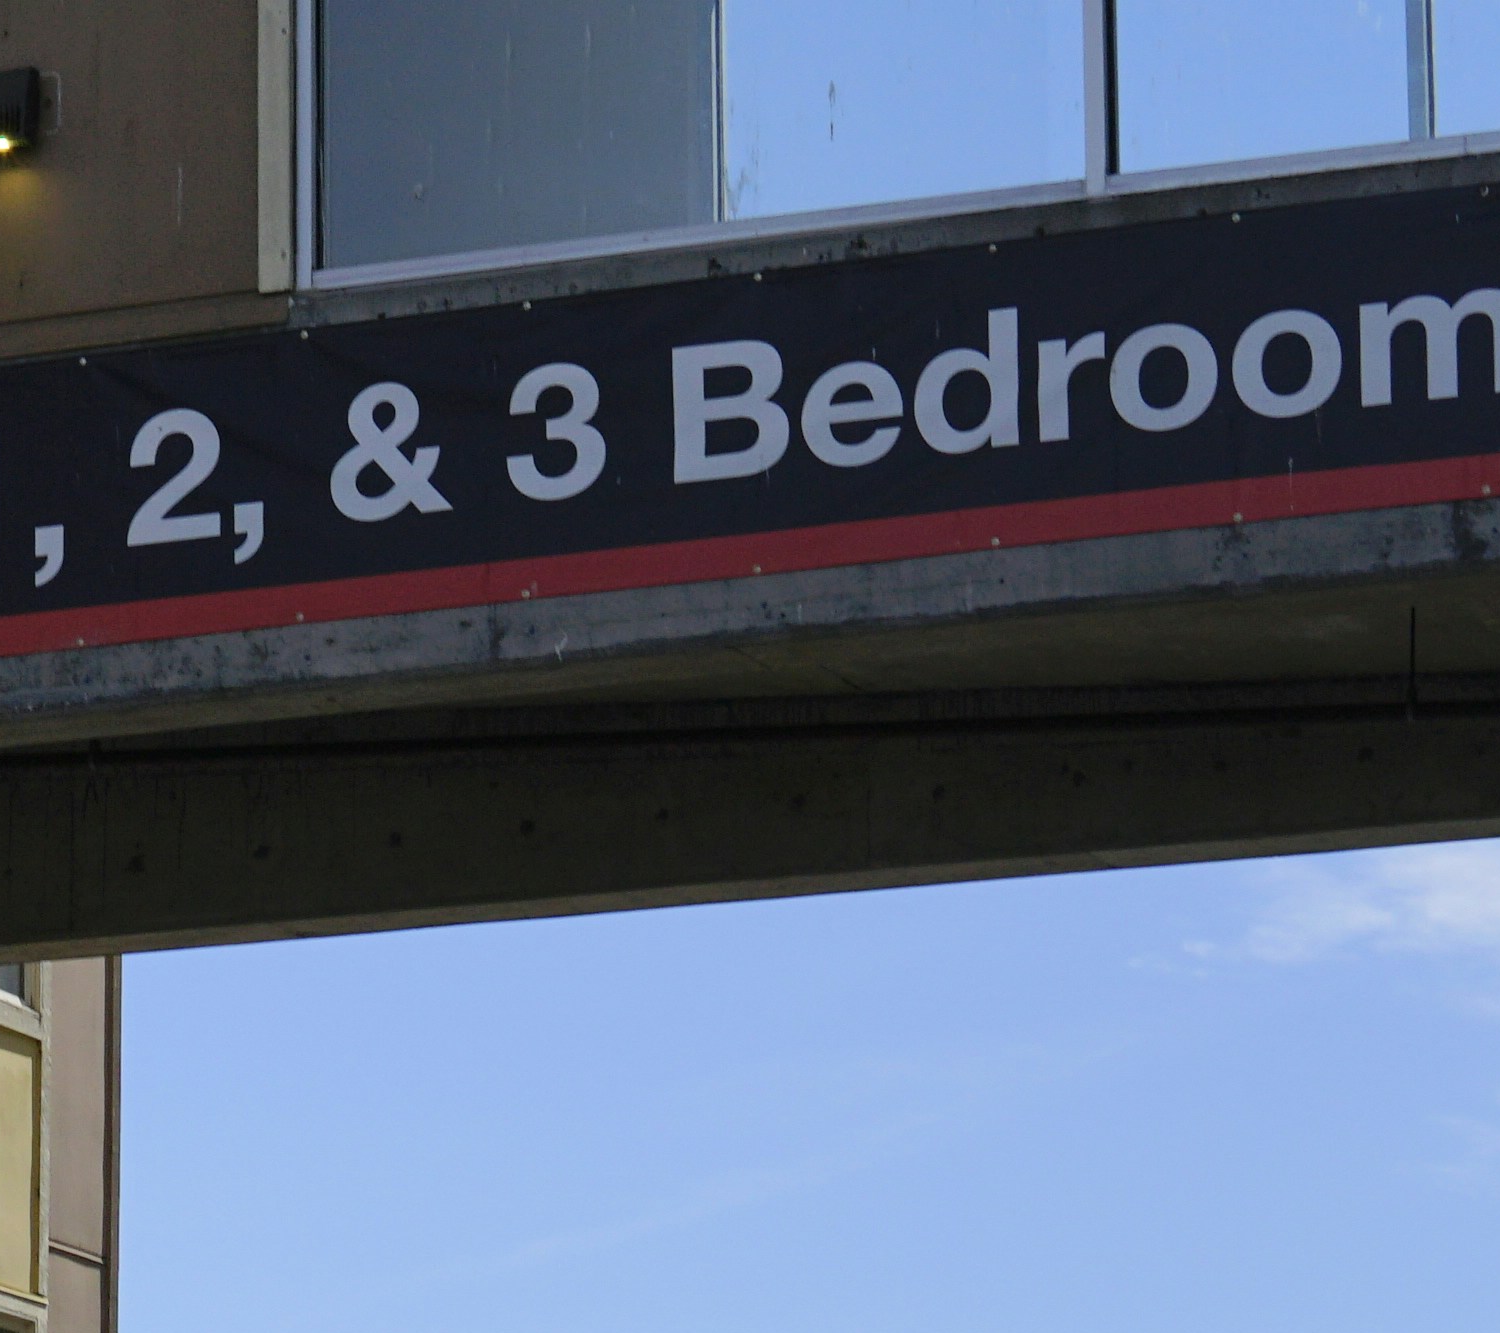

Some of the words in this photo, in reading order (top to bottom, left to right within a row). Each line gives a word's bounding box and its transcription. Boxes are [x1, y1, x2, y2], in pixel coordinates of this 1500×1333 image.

[127, 409, 263, 564] 2,
[331, 383, 452, 521] &
[507, 364, 605, 500] 3
